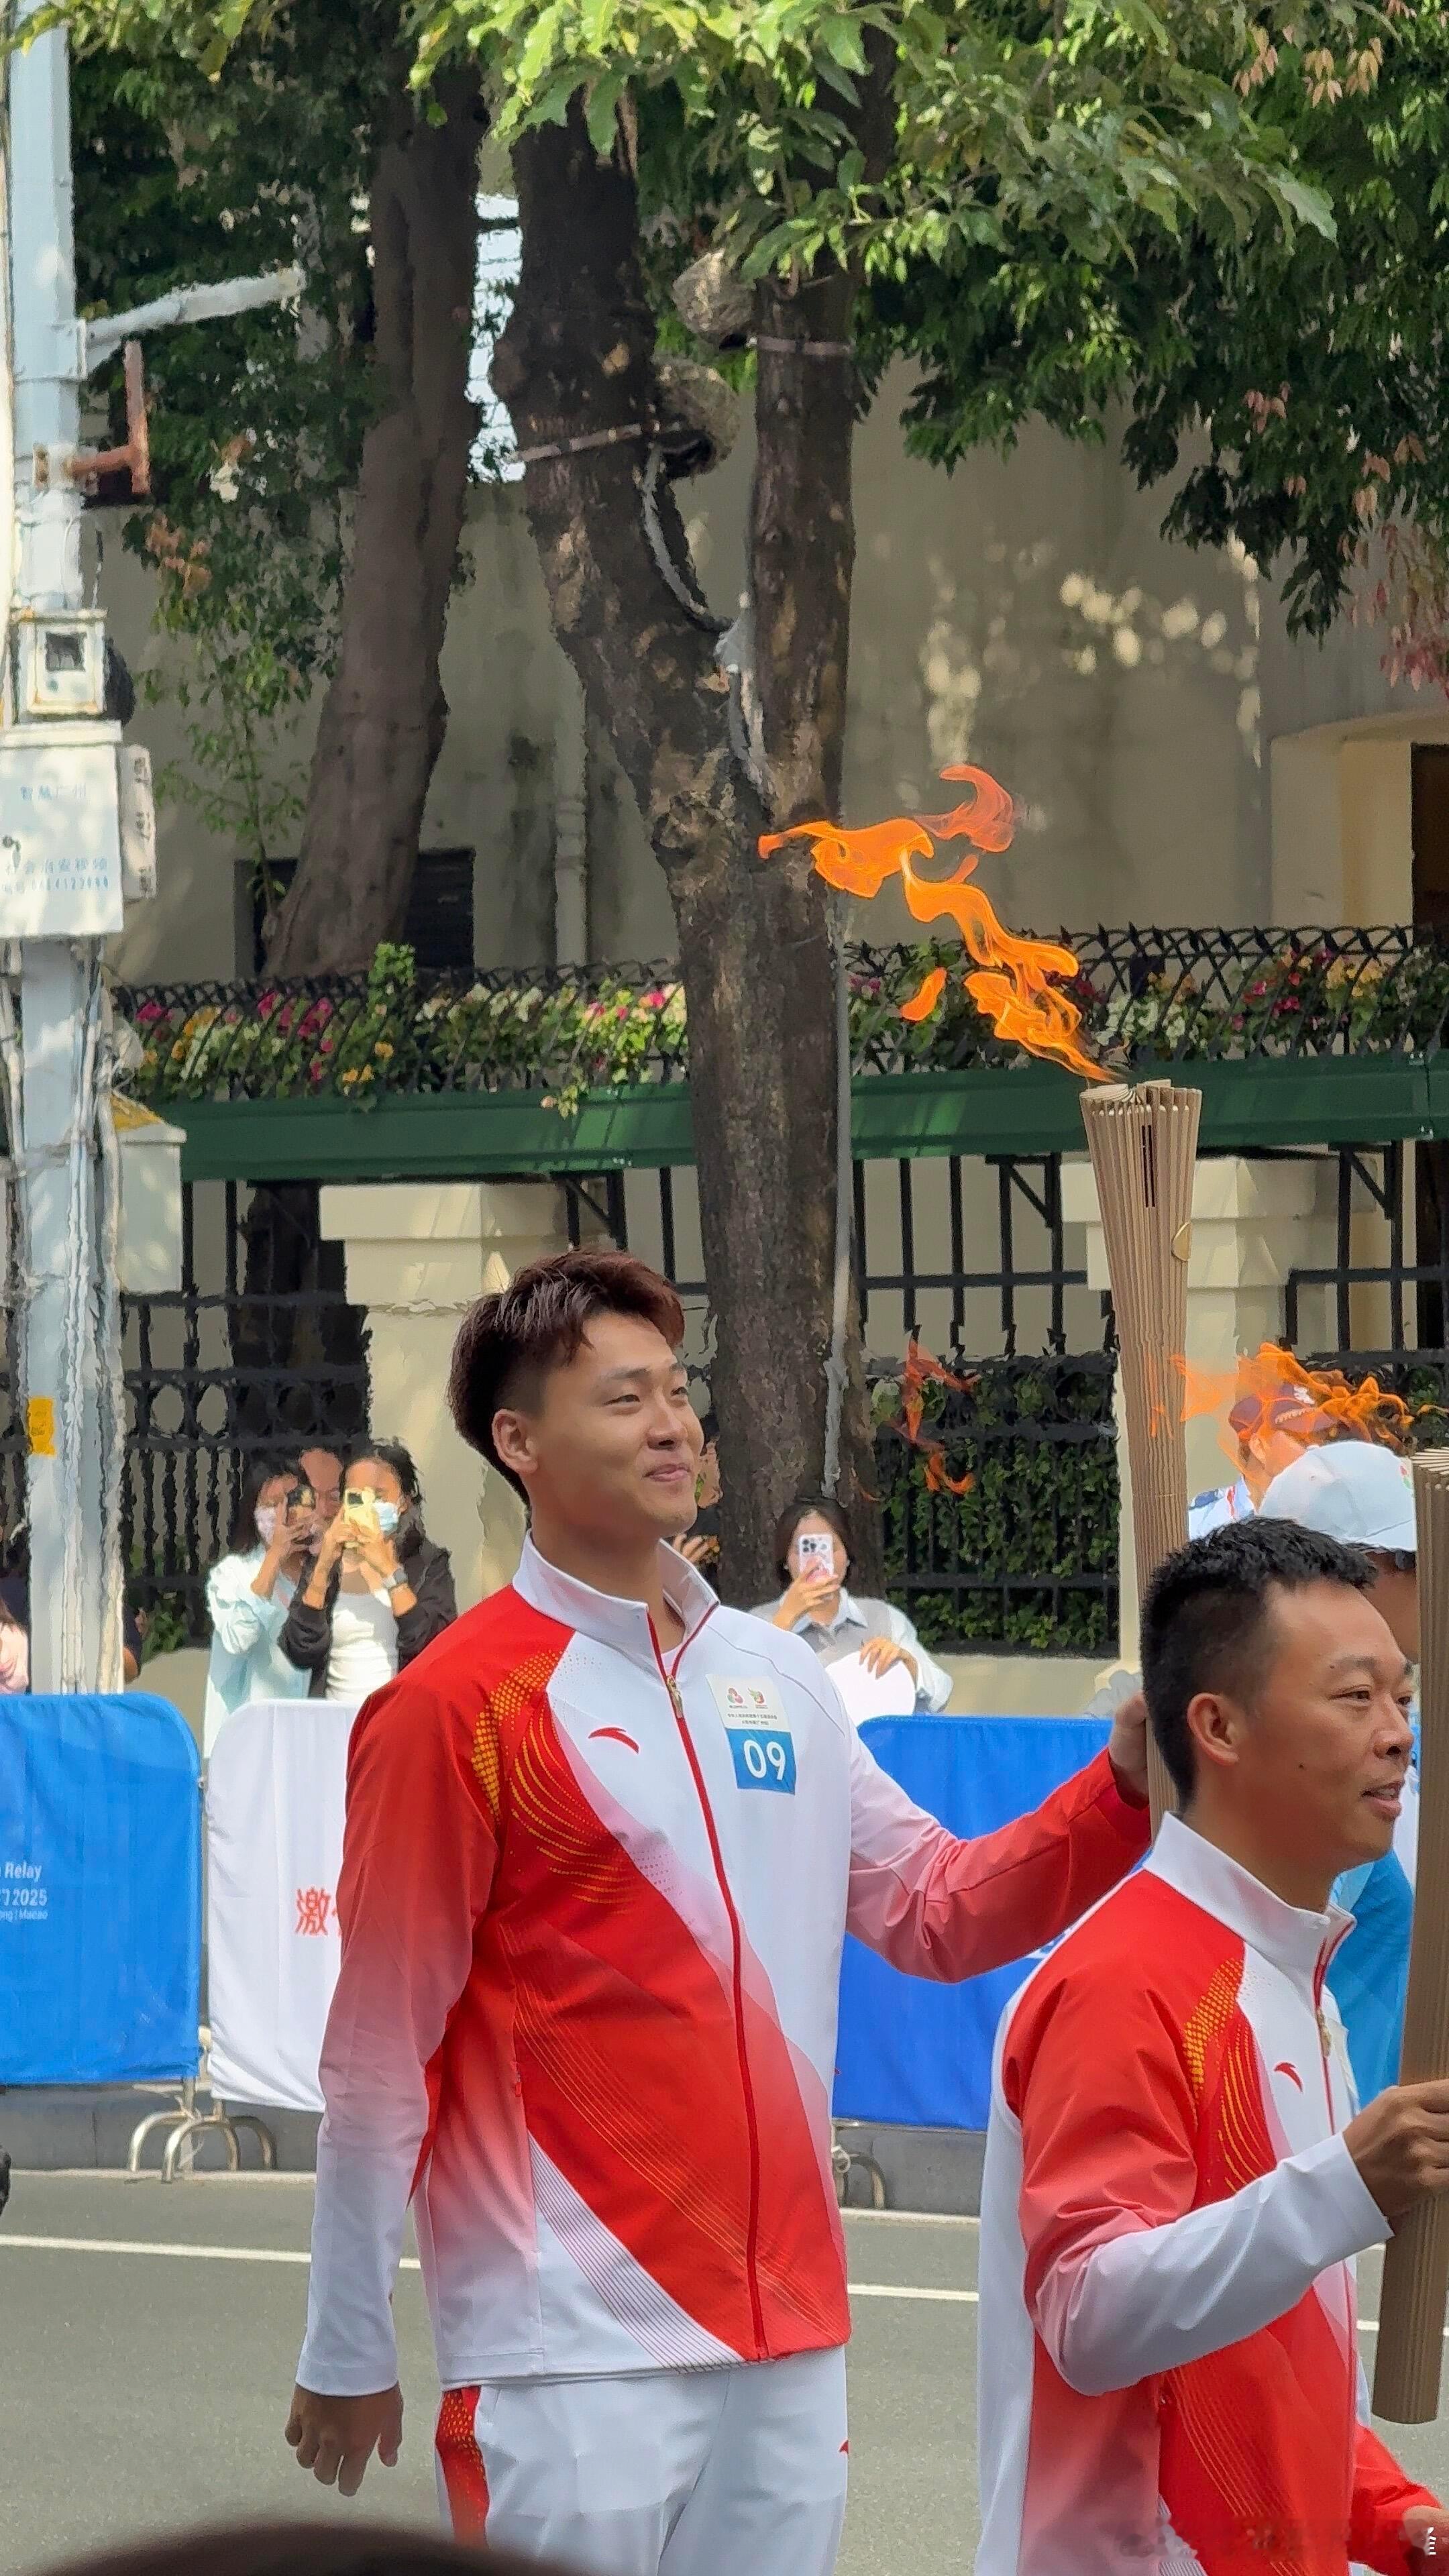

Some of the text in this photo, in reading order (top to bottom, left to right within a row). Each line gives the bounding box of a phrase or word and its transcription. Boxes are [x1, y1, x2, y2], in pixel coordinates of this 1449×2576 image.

[743, 1739, 786, 1781] 09
[4, 1860, 42, 1882] Relay
[11, 1888, 48, 1907] 2025
[295, 1886, 339, 1935] 激
